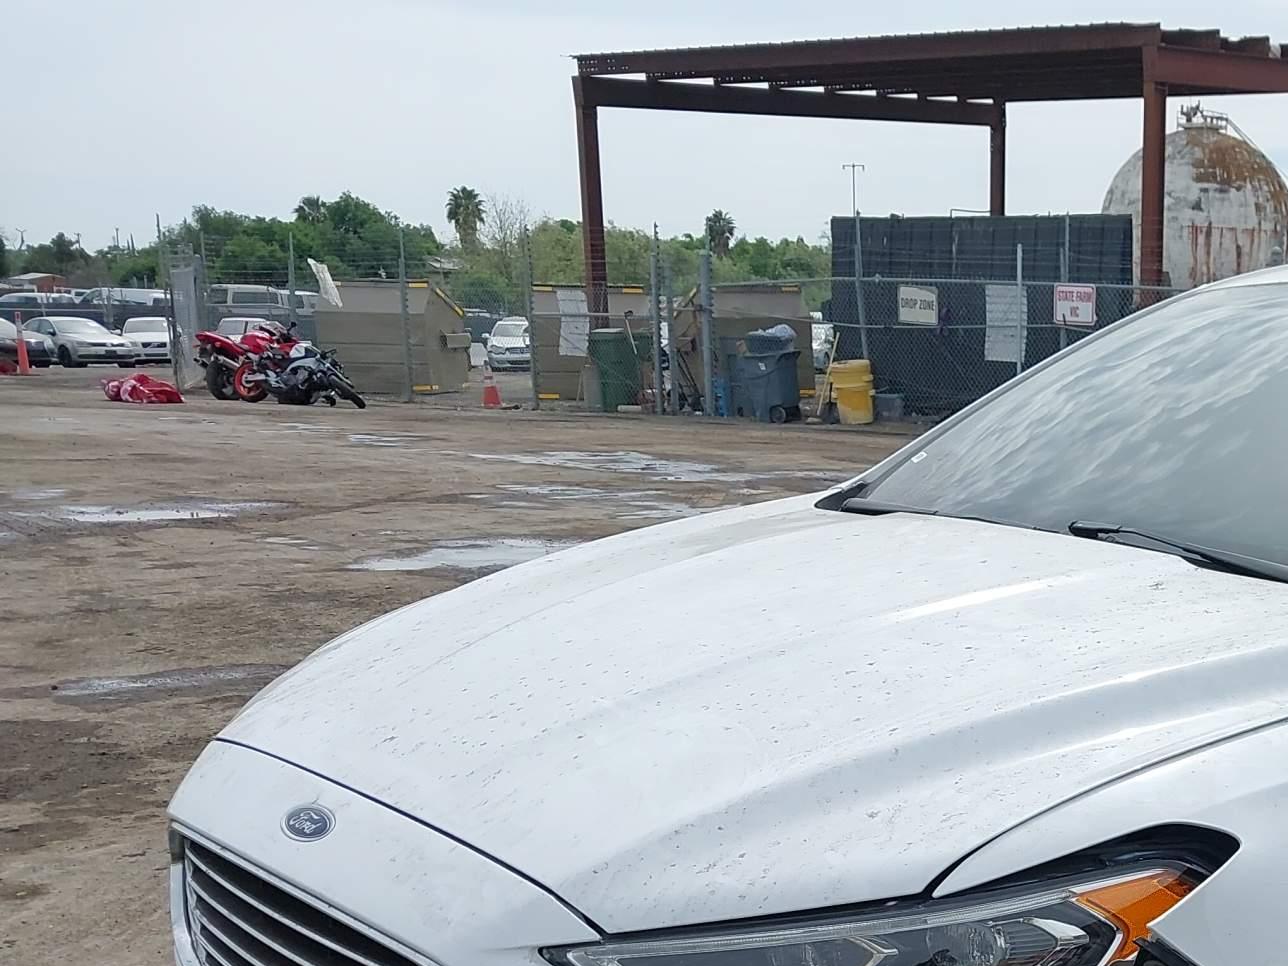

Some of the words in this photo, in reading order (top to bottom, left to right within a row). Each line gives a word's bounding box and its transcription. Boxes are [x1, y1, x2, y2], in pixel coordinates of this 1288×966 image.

[1056, 290, 1075, 303] STATE
[1076, 291, 1092, 303] FARM
[900, 297, 918, 310] DROP
[919, 298, 935, 312] ZONE
[289, 810, 323, 834] Ford
